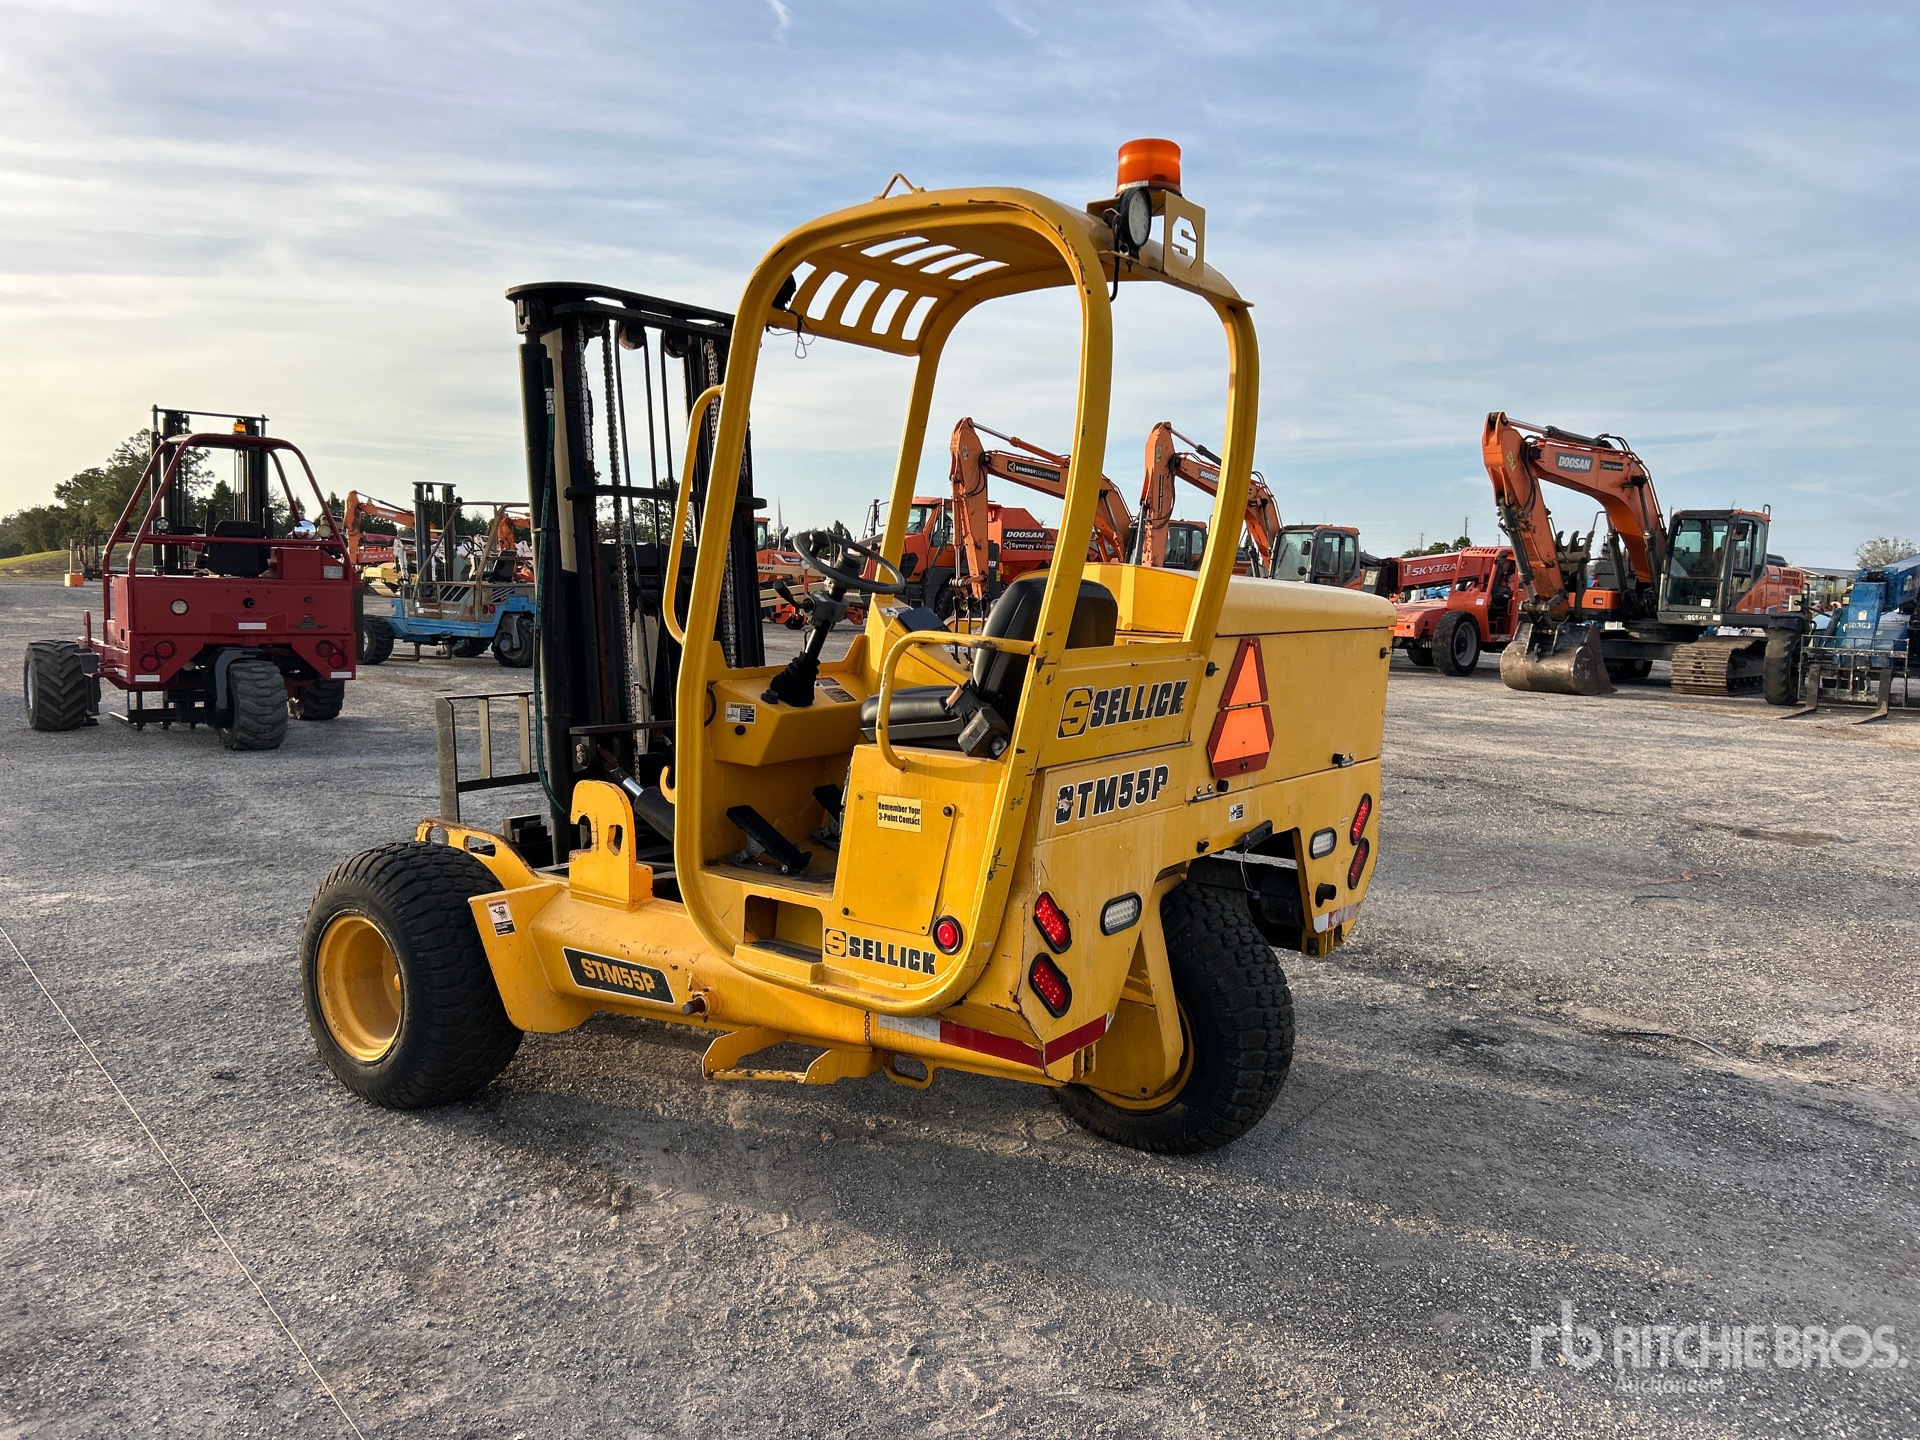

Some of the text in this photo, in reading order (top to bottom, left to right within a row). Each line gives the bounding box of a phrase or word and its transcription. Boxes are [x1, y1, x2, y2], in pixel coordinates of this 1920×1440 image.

[1558, 456, 1591, 470] DOOSAN
[1006, 531, 1045, 539] DOOSAN
[1090, 680, 1187, 728] SELLICK
[878, 802, 920, 815] Remember Your
[879, 812, 920, 825] 3-Point Contact
[849, 935, 936, 975] SELLICK
[580, 957, 655, 993] STM55P
